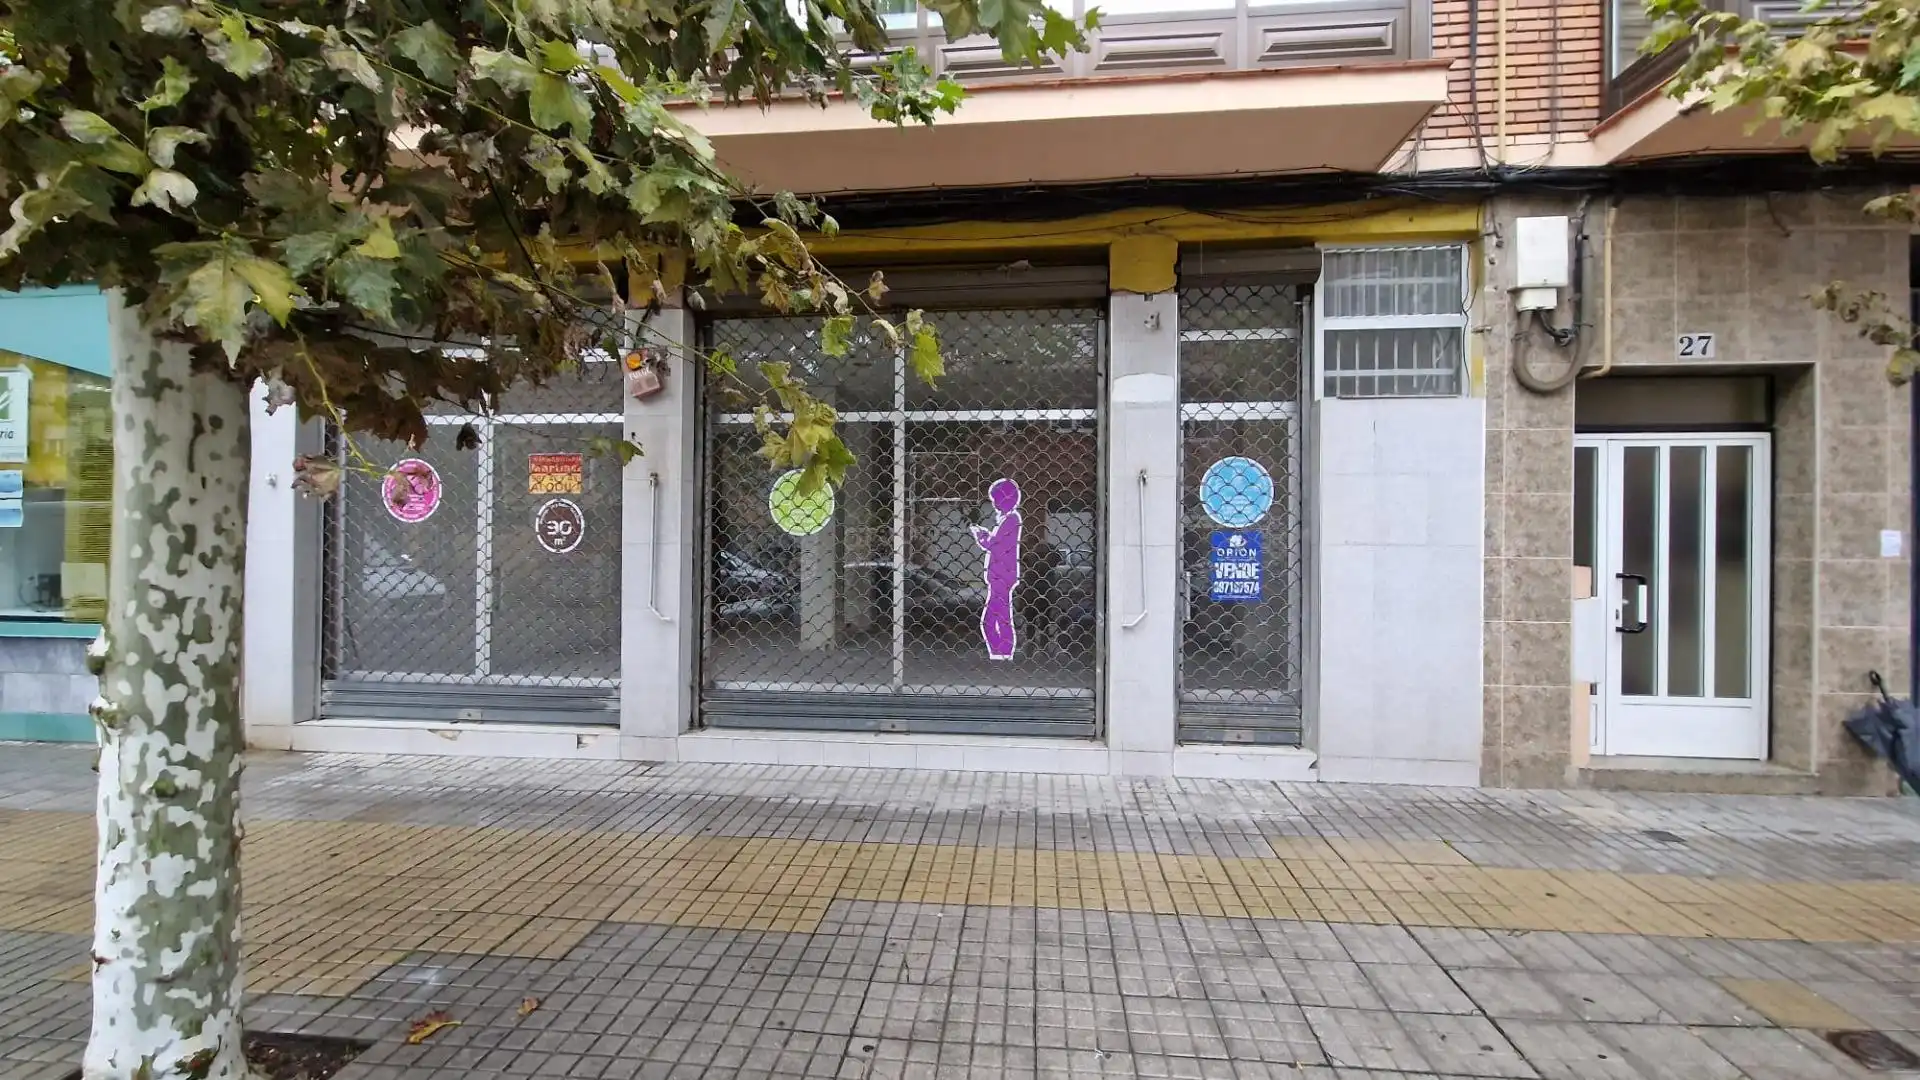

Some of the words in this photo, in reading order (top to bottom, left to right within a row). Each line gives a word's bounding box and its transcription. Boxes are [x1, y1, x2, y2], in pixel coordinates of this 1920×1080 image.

[1679, 335, 1712, 356] 27
[546, 520, 572, 536] 30
[1214, 562, 1260, 579] VENDE
